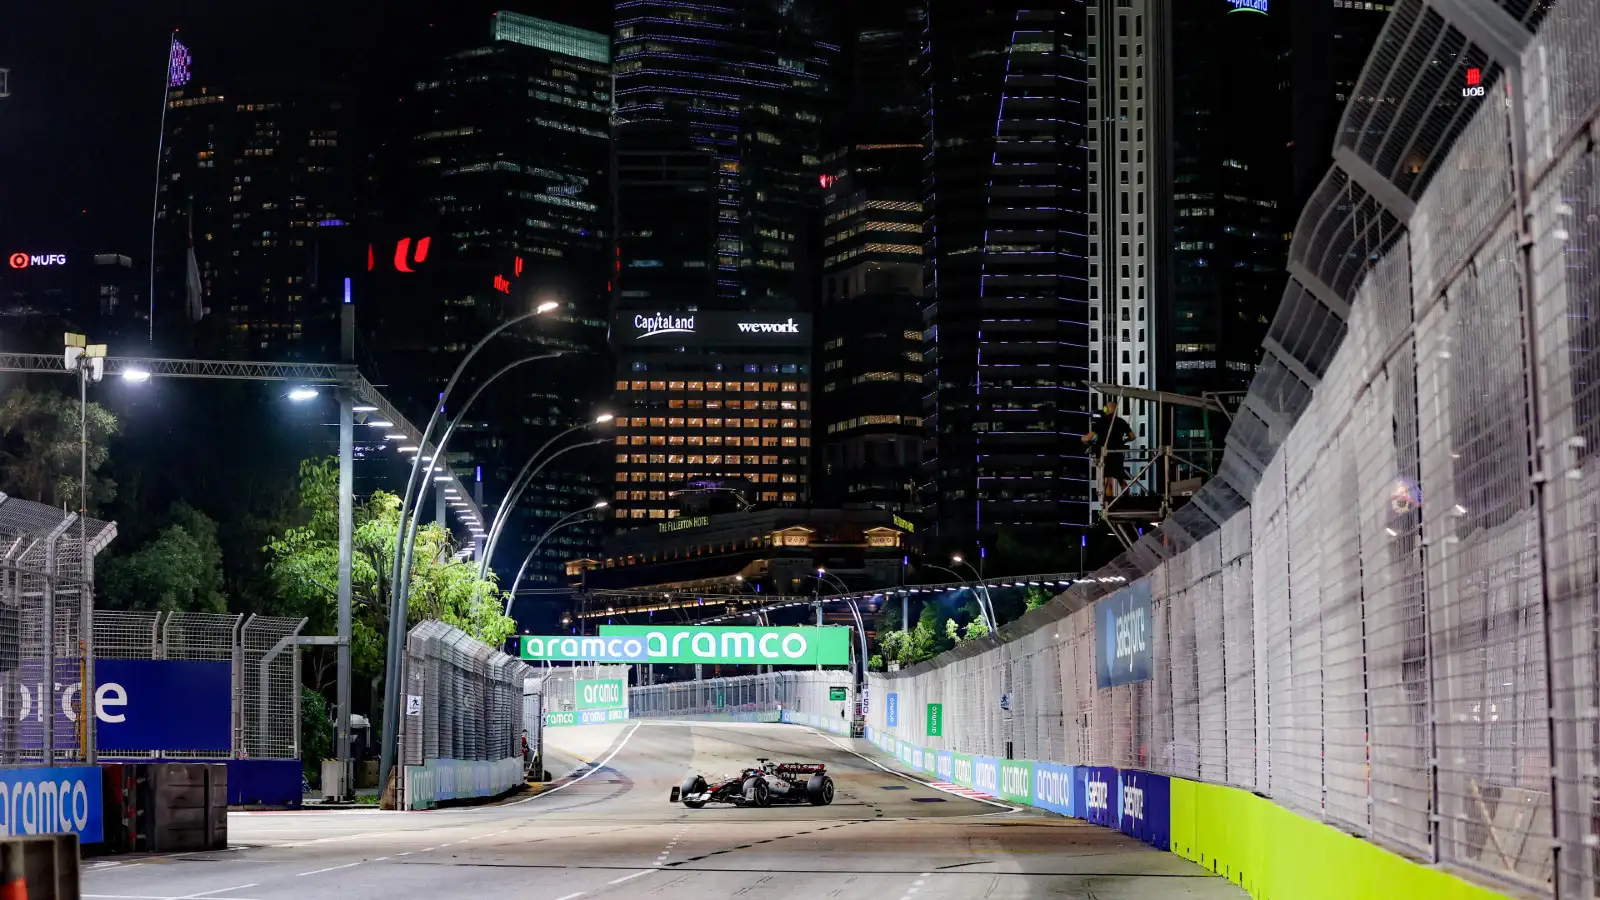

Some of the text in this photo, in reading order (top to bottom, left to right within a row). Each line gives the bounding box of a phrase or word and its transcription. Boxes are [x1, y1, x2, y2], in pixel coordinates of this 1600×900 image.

[1227, 0, 1269, 11] pitaLand
[1462, 86, 1485, 97] UOB
[30, 254, 66, 266] MUFG
[634, 312, 694, 332] CapitaLand
[737, 318, 799, 333] wework
[646, 631, 808, 659] aramco
[1116, 594, 1145, 673] salesforce
[526, 637, 642, 658] aramco
[584, 683, 619, 704] aramco
[1002, 764, 1029, 797] aramco
[1037, 768, 1070, 807] aramco
[0, 780, 88, 836] aramco
[1089, 771, 1109, 821] salesforce
[1124, 775, 1144, 831] salesforce
